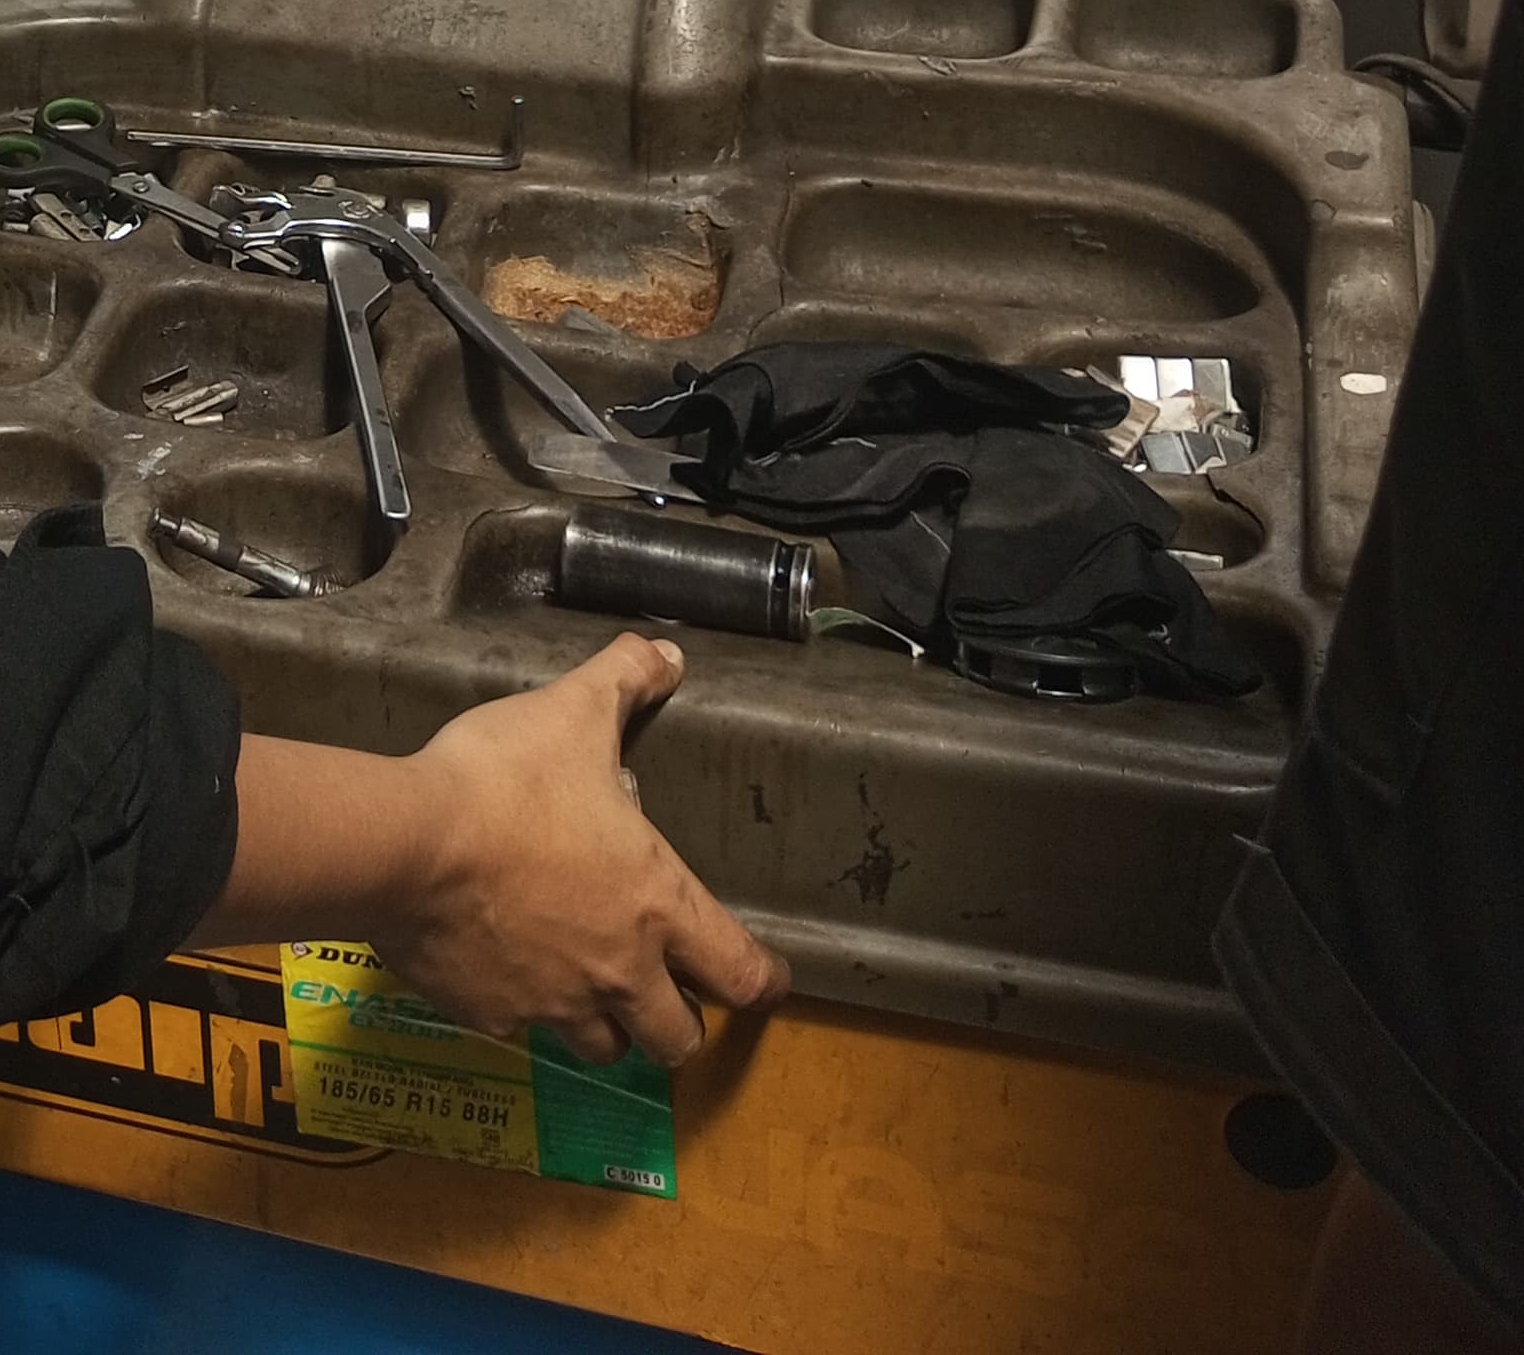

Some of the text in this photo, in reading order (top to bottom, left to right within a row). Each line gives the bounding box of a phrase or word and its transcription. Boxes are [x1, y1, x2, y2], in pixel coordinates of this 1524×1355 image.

[317, 946, 384, 970] DUN
[318, 1076, 396, 1108] 185/65
[404, 1093, 452, 1118] R15
[462, 1102, 510, 1128] 88H
